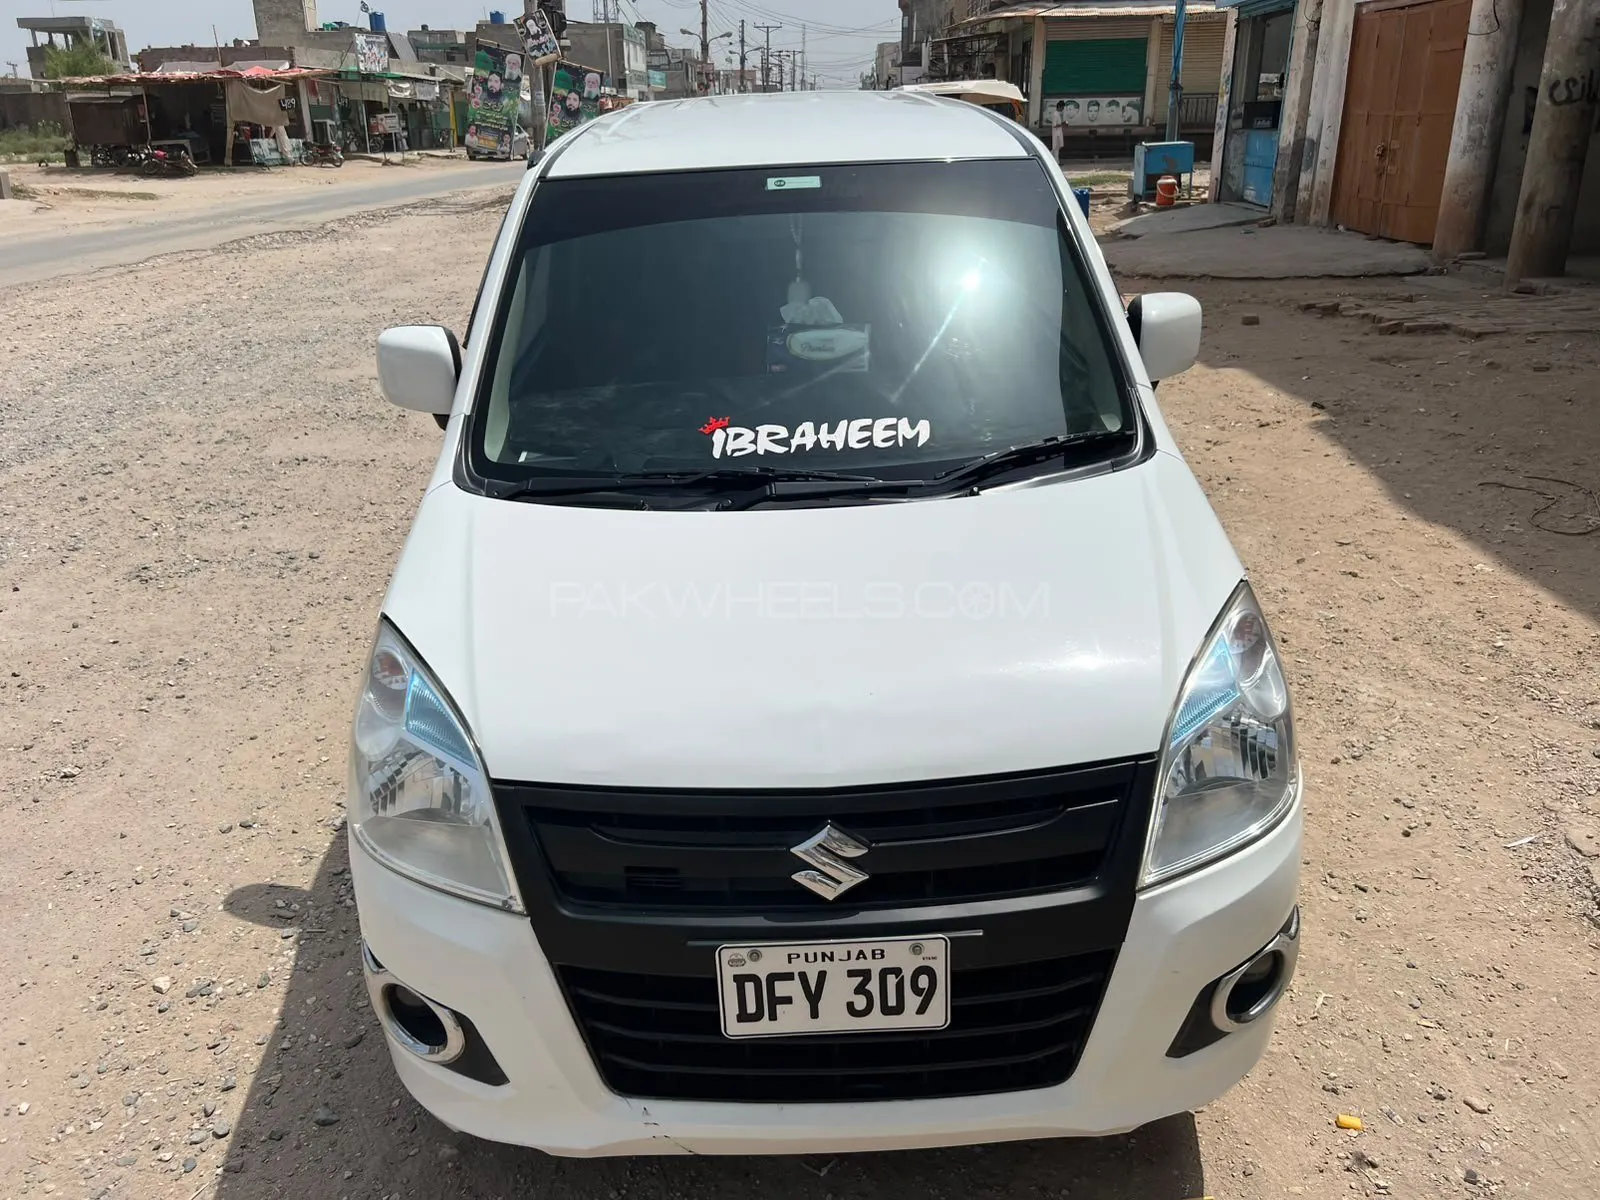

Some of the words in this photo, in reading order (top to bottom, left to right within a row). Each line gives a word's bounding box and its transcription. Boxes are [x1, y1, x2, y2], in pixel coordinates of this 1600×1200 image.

[787, 948, 886, 964] PUNJAB
[732, 970, 828, 1024] DFY
[845, 965, 938, 1018] 309
